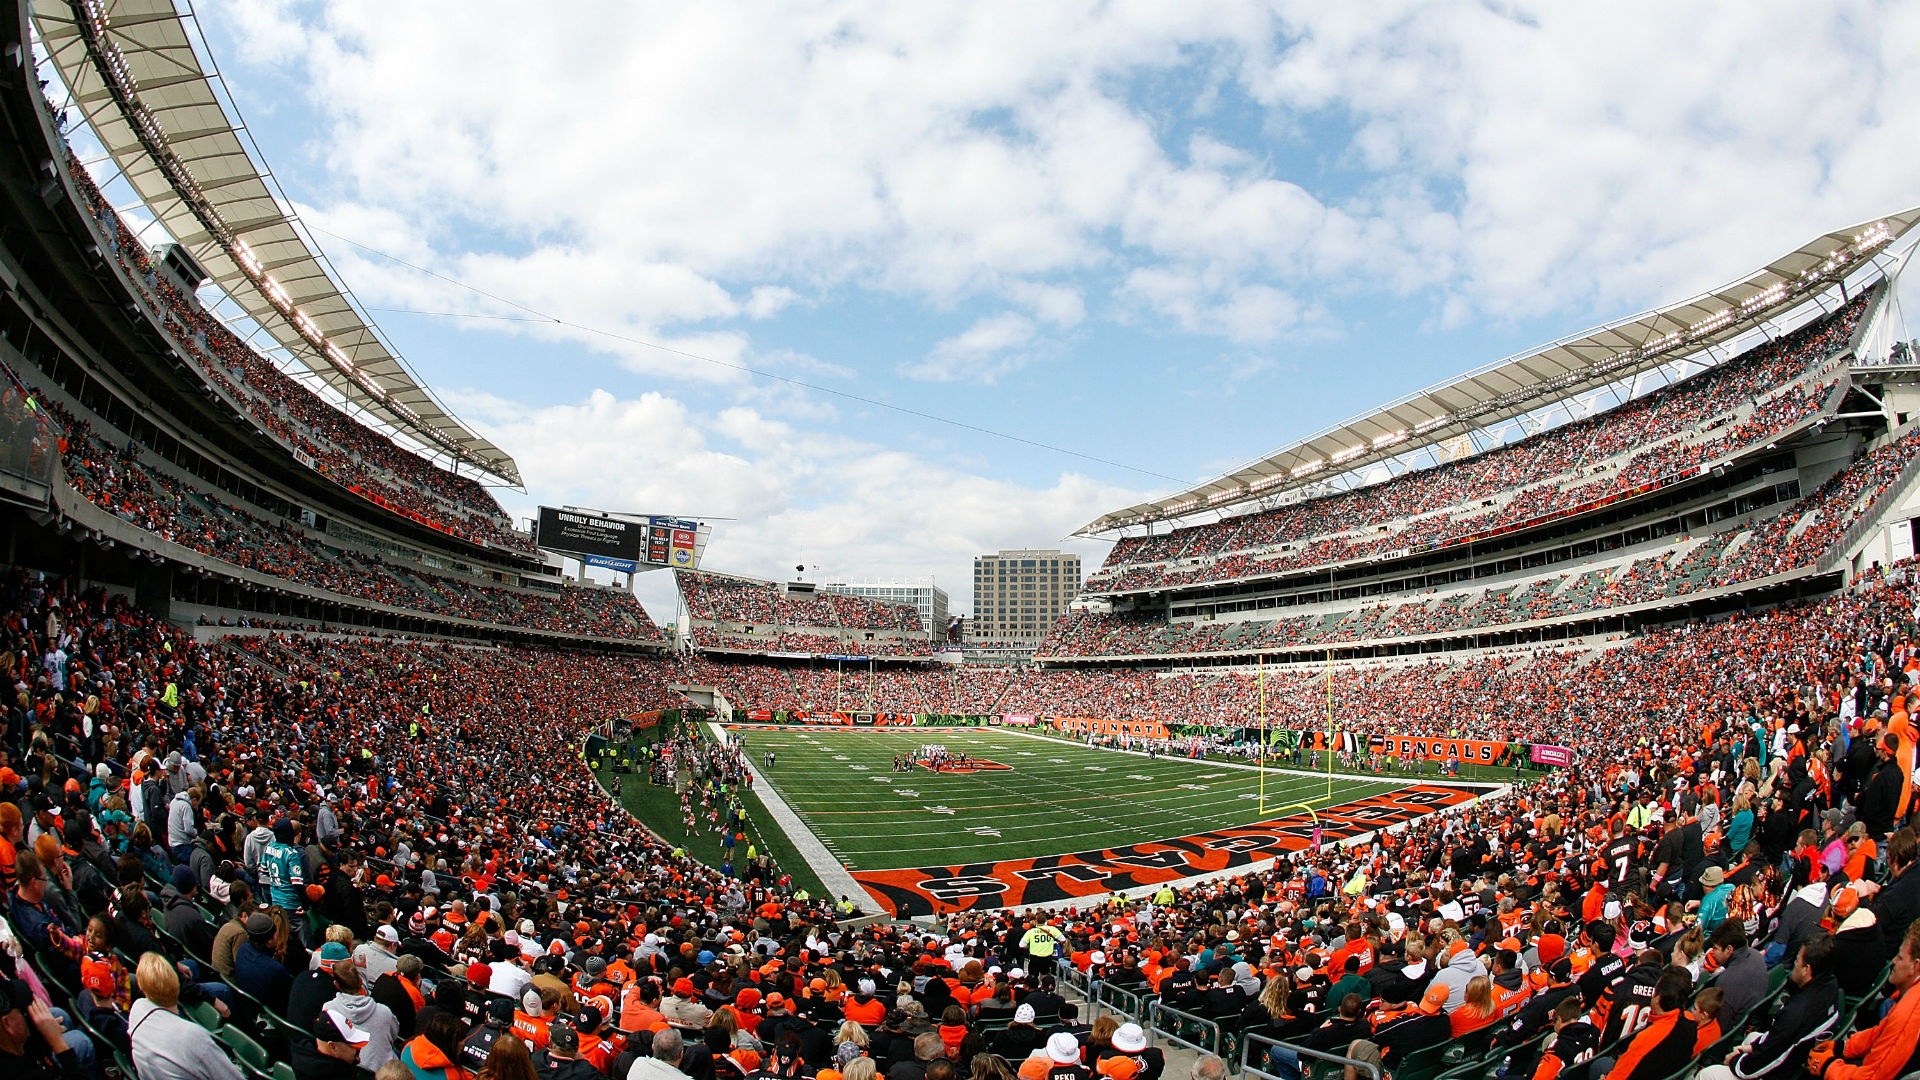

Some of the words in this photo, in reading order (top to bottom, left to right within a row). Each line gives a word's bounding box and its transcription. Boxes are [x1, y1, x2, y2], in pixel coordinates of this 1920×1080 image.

[558, 513, 588, 524] UNRULY
[589, 518, 626, 531] BEHAVIOR
[608, 560, 632, 568] LIGHT
[1061, 720, 1162, 735] CINCINNATI
[1385, 740, 1492, 760] BENGALS
[916, 791, 1454, 900] BENGALS
[1615, 855, 1629, 882] 7
[1288, 889, 1299, 900] 85
[1601, 958, 1623, 976] BENGALS
[1172, 980, 1192, 989] PALMER
